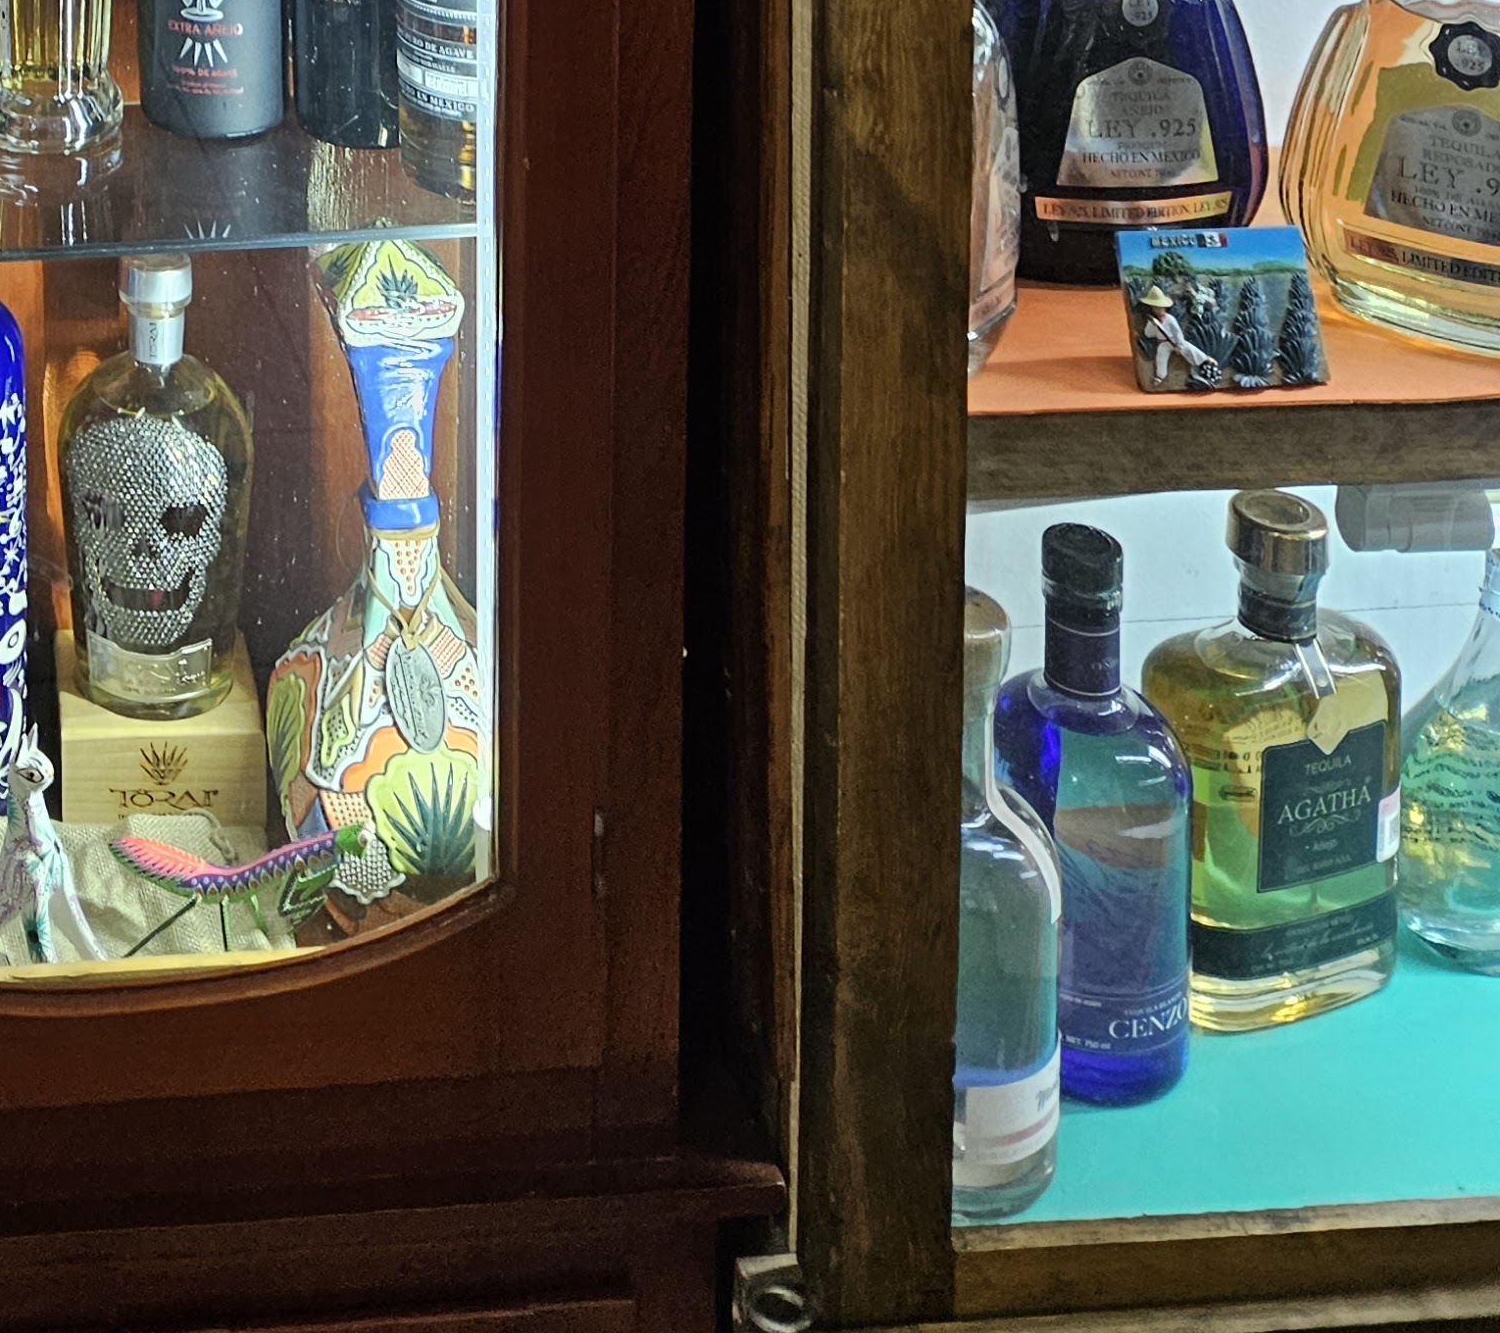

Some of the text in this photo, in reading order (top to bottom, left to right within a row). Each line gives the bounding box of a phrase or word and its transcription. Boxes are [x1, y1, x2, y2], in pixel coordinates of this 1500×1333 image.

[167, 19, 201, 35] EXTRA
[1085, 118, 1198, 140] LEY .925
[1082, 151, 1130, 165] HECHO
[1130, 151, 1150, 164] EN
[1399, 155, 1464, 189] LEY
[1390, 189, 1445, 213] HECHO
[1463, 262, 1500, 284] EDIT
[1306, 754, 1352, 776] TEQUILA
